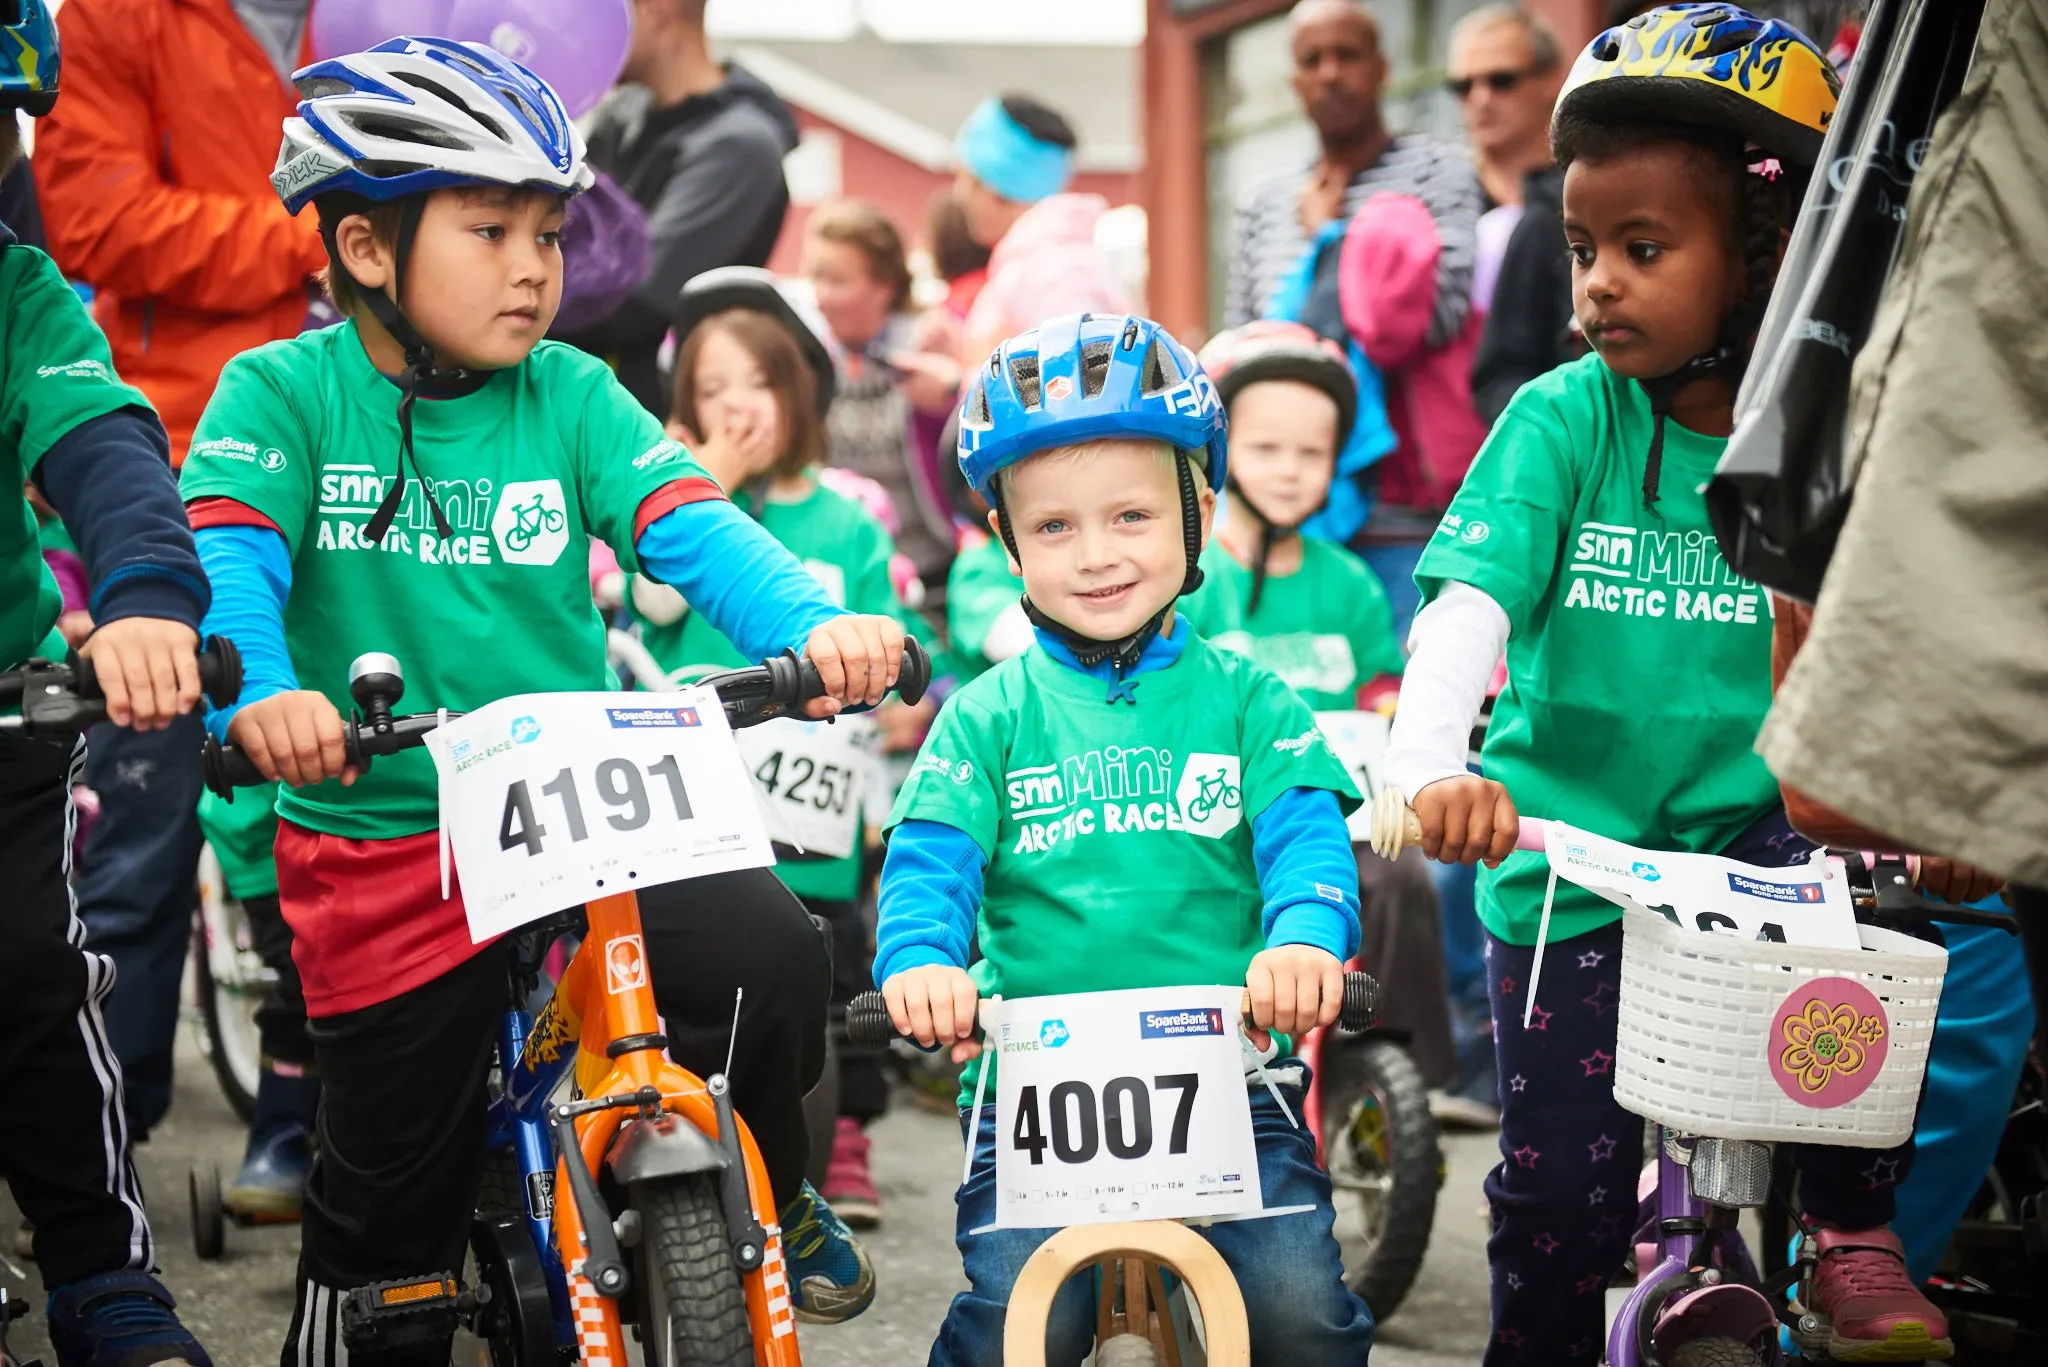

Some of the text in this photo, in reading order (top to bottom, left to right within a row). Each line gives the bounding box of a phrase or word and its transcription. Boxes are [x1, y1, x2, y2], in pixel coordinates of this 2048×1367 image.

[419, 533, 491, 565] RACE
[1574, 531, 1633, 566] snn
[1675, 588, 1759, 624] RACE
[612, 710, 675, 722] SpareBank
[486, 740, 513, 758] RACE
[1008, 745, 1173, 809] snn Mini
[498, 754, 694, 857] 4191
[1103, 802, 1185, 833] RACE
[1604, 866, 1633, 878] RACE
[1734, 876, 1797, 895] SpareBank
[1752, 889, 1799, 901] NORD-NORGE
[1146, 1012, 1207, 1029] SpareBank
[1165, 1025, 1209, 1034] NORD-NORGE
[1016, 1040, 1039, 1053] RACE
[1013, 1073, 1199, 1165] 4007
